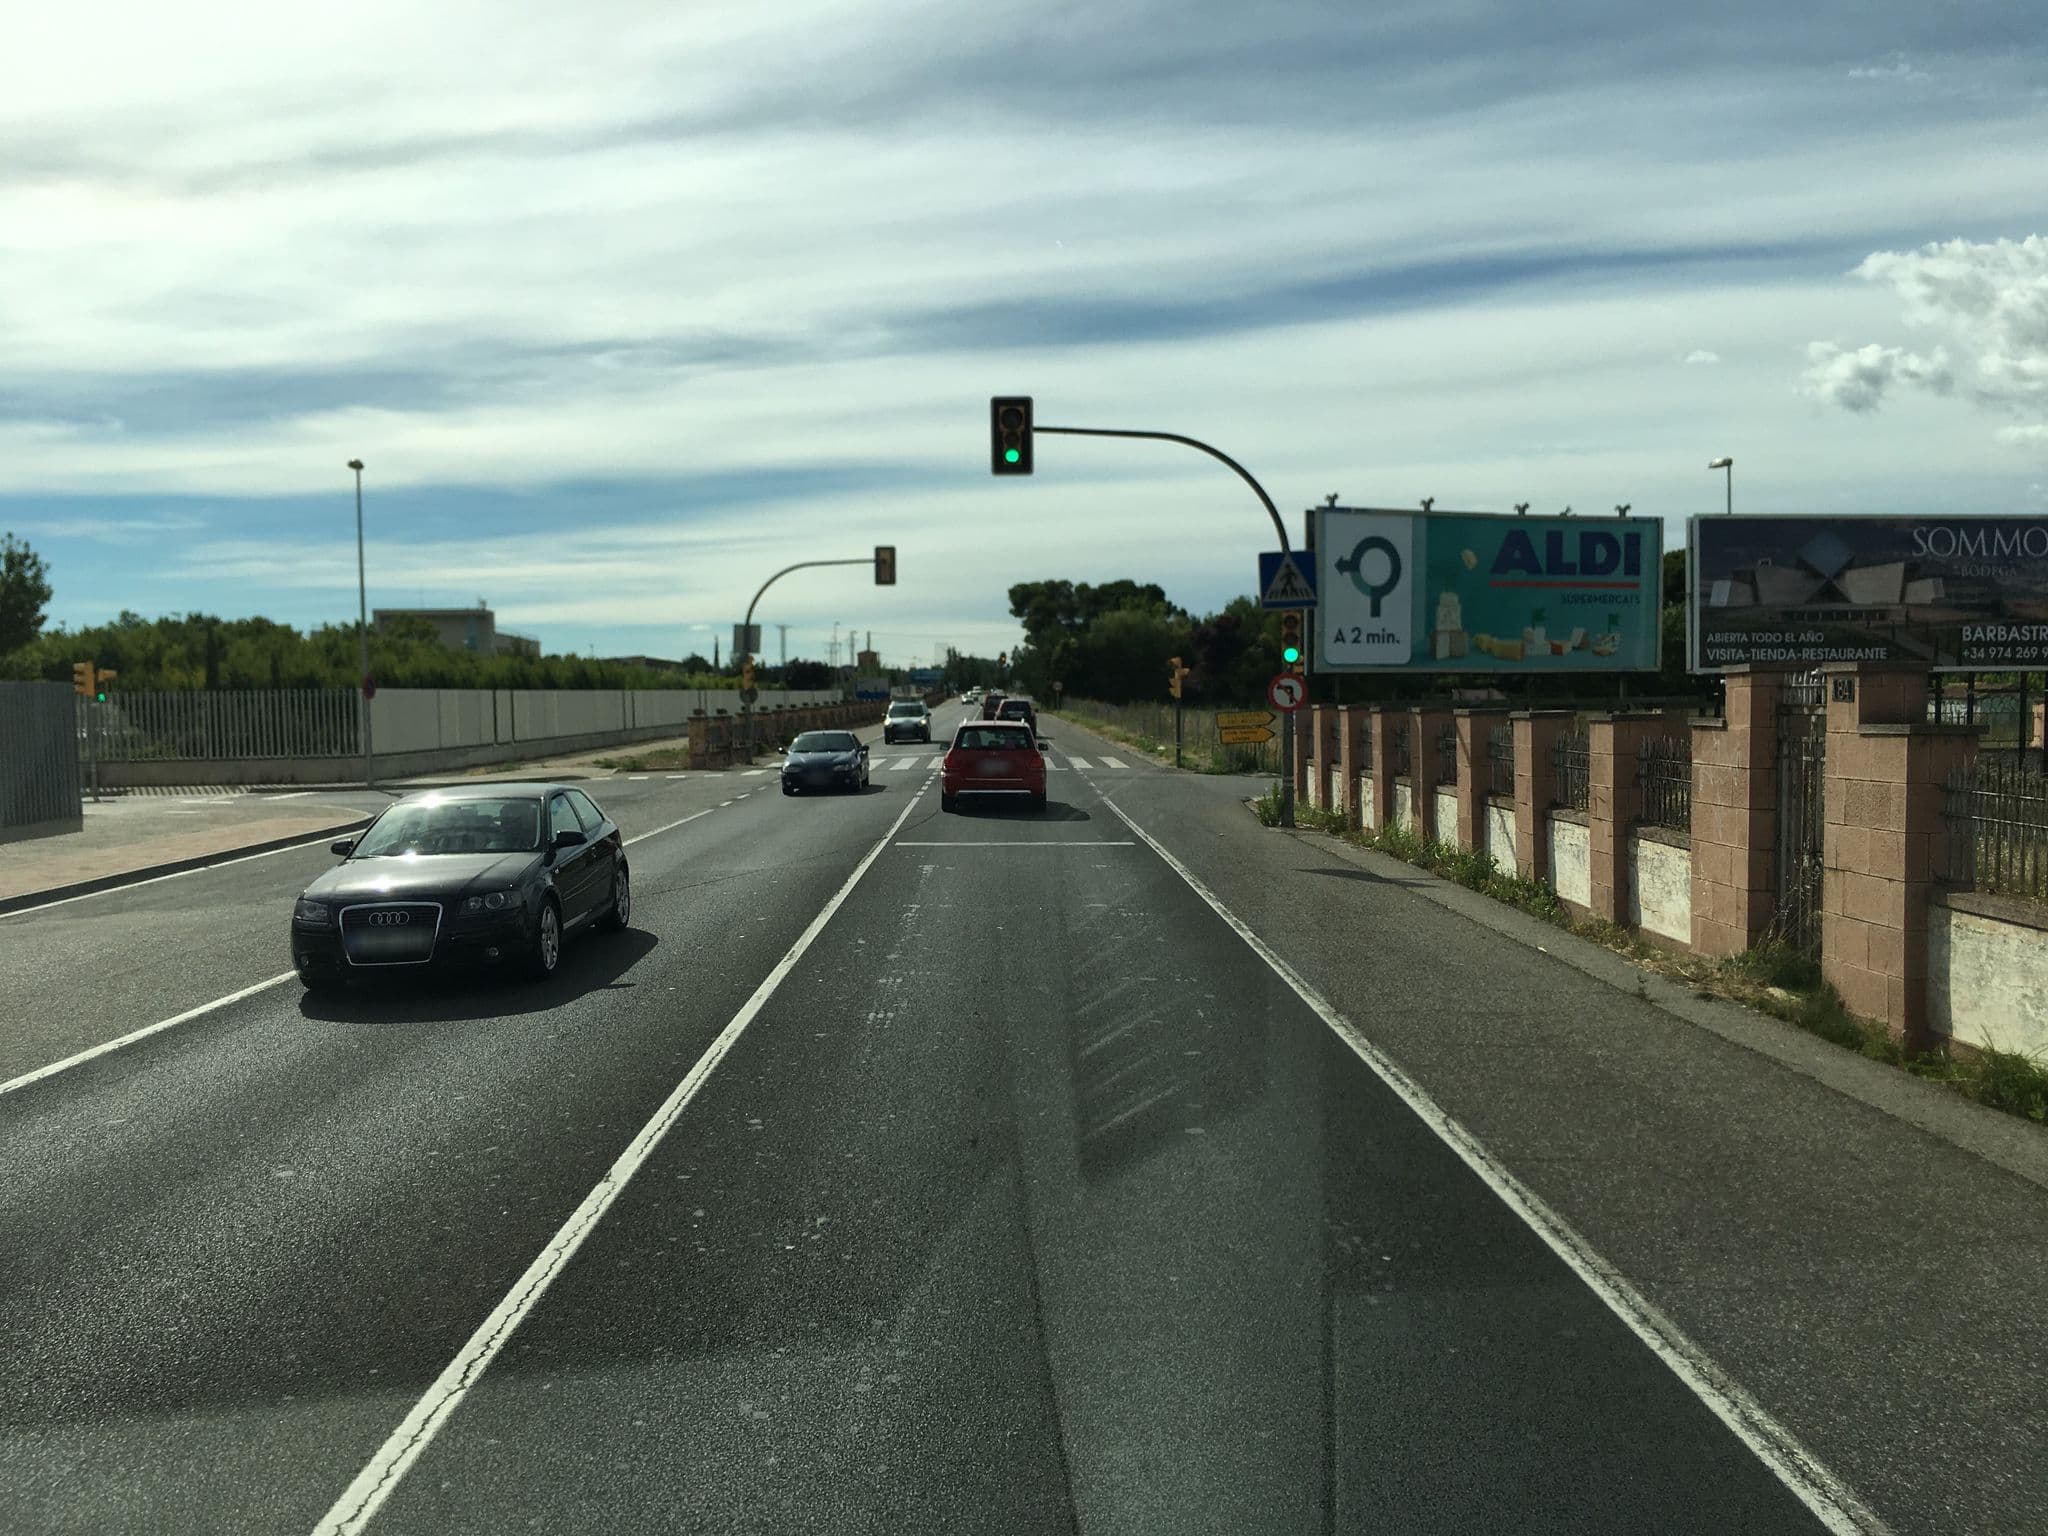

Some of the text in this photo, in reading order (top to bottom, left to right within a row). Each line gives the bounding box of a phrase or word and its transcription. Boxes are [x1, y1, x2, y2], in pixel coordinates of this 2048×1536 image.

[1489, 529, 1642, 577] ALDI
[1961, 565, 2018, 577] BODEGA
[1333, 627, 1400, 645] A 2 min.
[1706, 630, 1825, 643] ABIERTA TODO EL AÑO
[1962, 646, 1985, 659] +34
[1988, 646, 2012, 659] 974
[2015, 646, 2038, 659] 269
